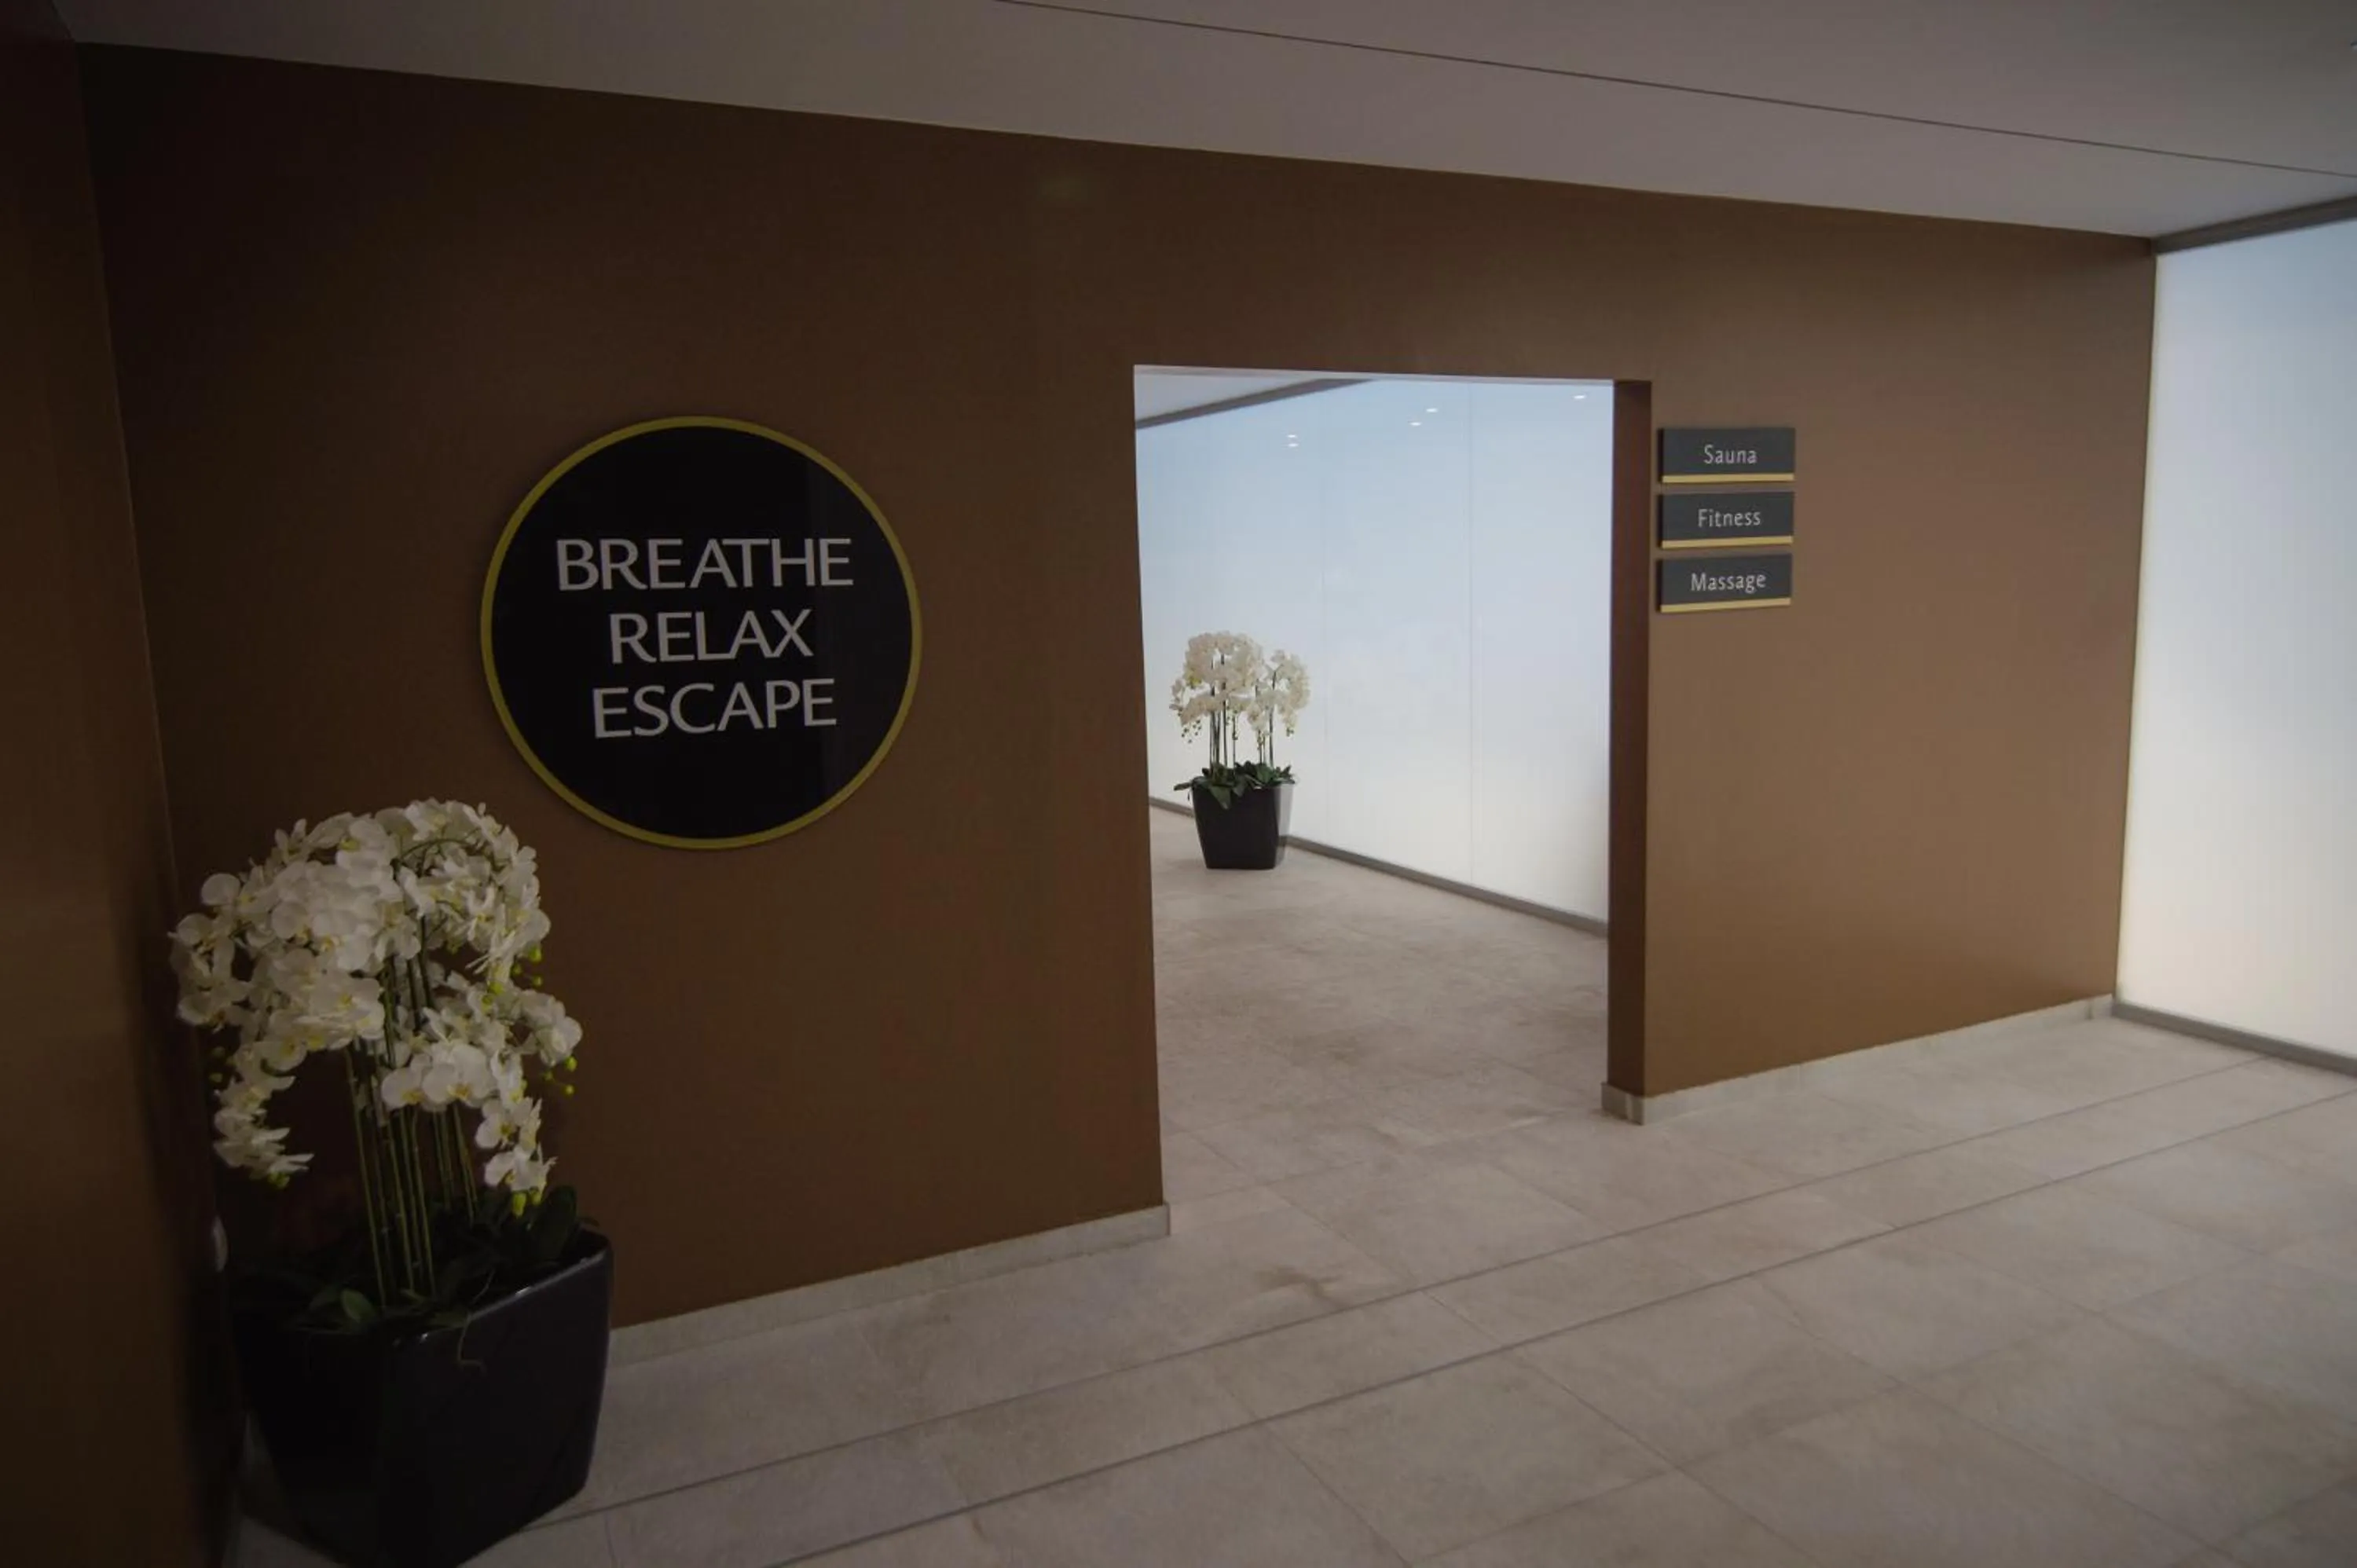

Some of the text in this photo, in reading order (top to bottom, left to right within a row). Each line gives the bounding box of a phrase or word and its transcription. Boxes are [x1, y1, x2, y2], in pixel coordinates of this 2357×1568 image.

[1703, 444, 1758, 464] Sauna
[1698, 508, 1761, 528] Fitness
[556, 537, 854, 591] BREATHE
[1691, 573, 1767, 595] Massage
[609, 608, 814, 665] RELAX
[592, 678, 838, 738] ESCAPE
